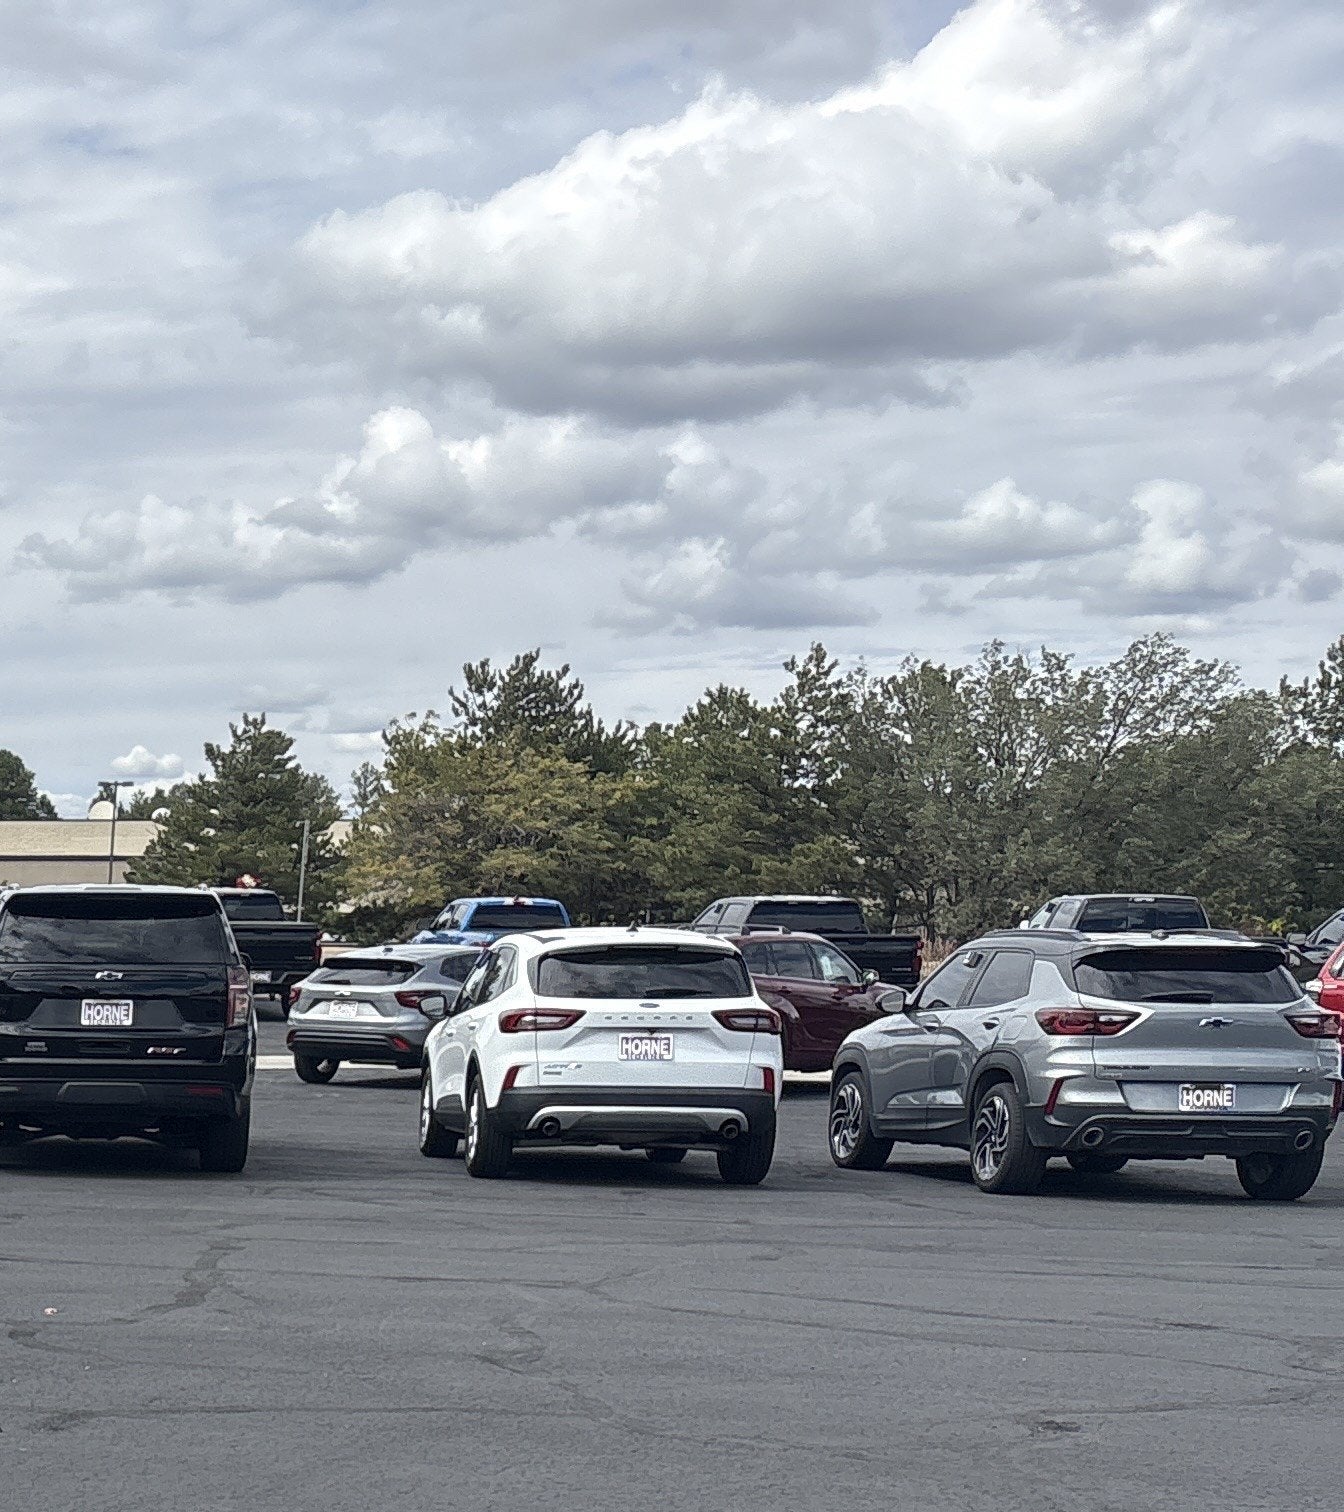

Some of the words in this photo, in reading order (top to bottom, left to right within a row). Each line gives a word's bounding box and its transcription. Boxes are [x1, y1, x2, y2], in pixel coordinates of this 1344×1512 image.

[84, 1005, 129, 1021] HORNE
[622, 1038, 670, 1055] HORNE
[1182, 1089, 1232, 1106] HORNE
